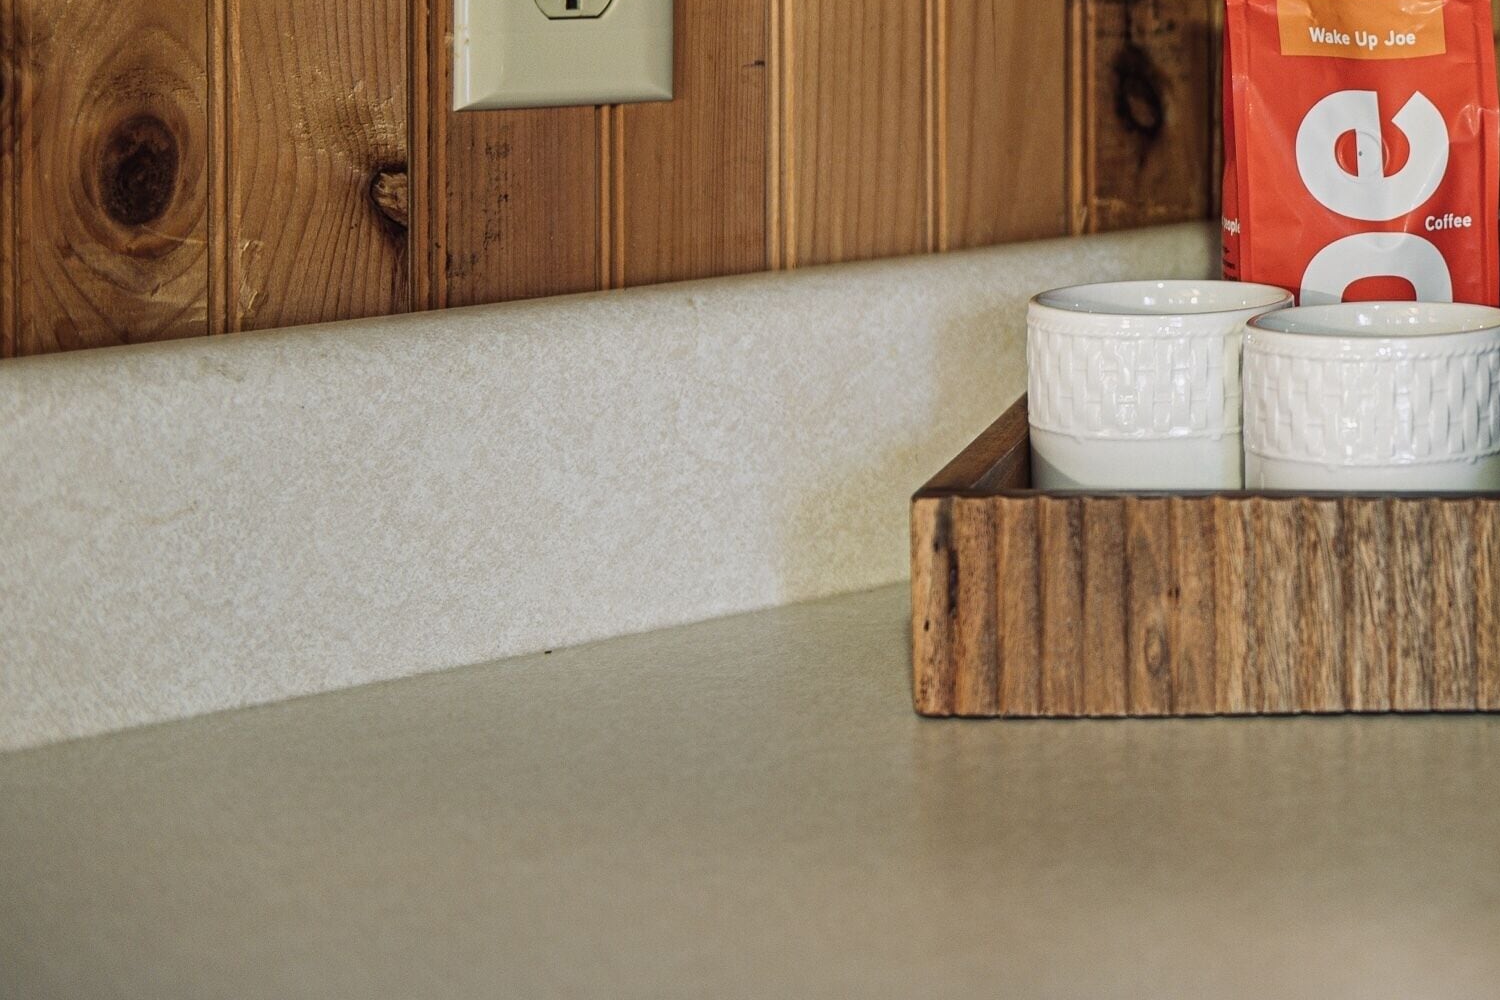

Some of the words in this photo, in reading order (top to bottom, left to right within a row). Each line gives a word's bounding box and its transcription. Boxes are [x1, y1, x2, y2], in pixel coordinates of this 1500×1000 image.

[1308, 26, 1350, 45] Wake
[1355, 31, 1378, 51] Up
[1384, 30, 1416, 46] Joe
[1425, 213, 1473, 231] Coffee
